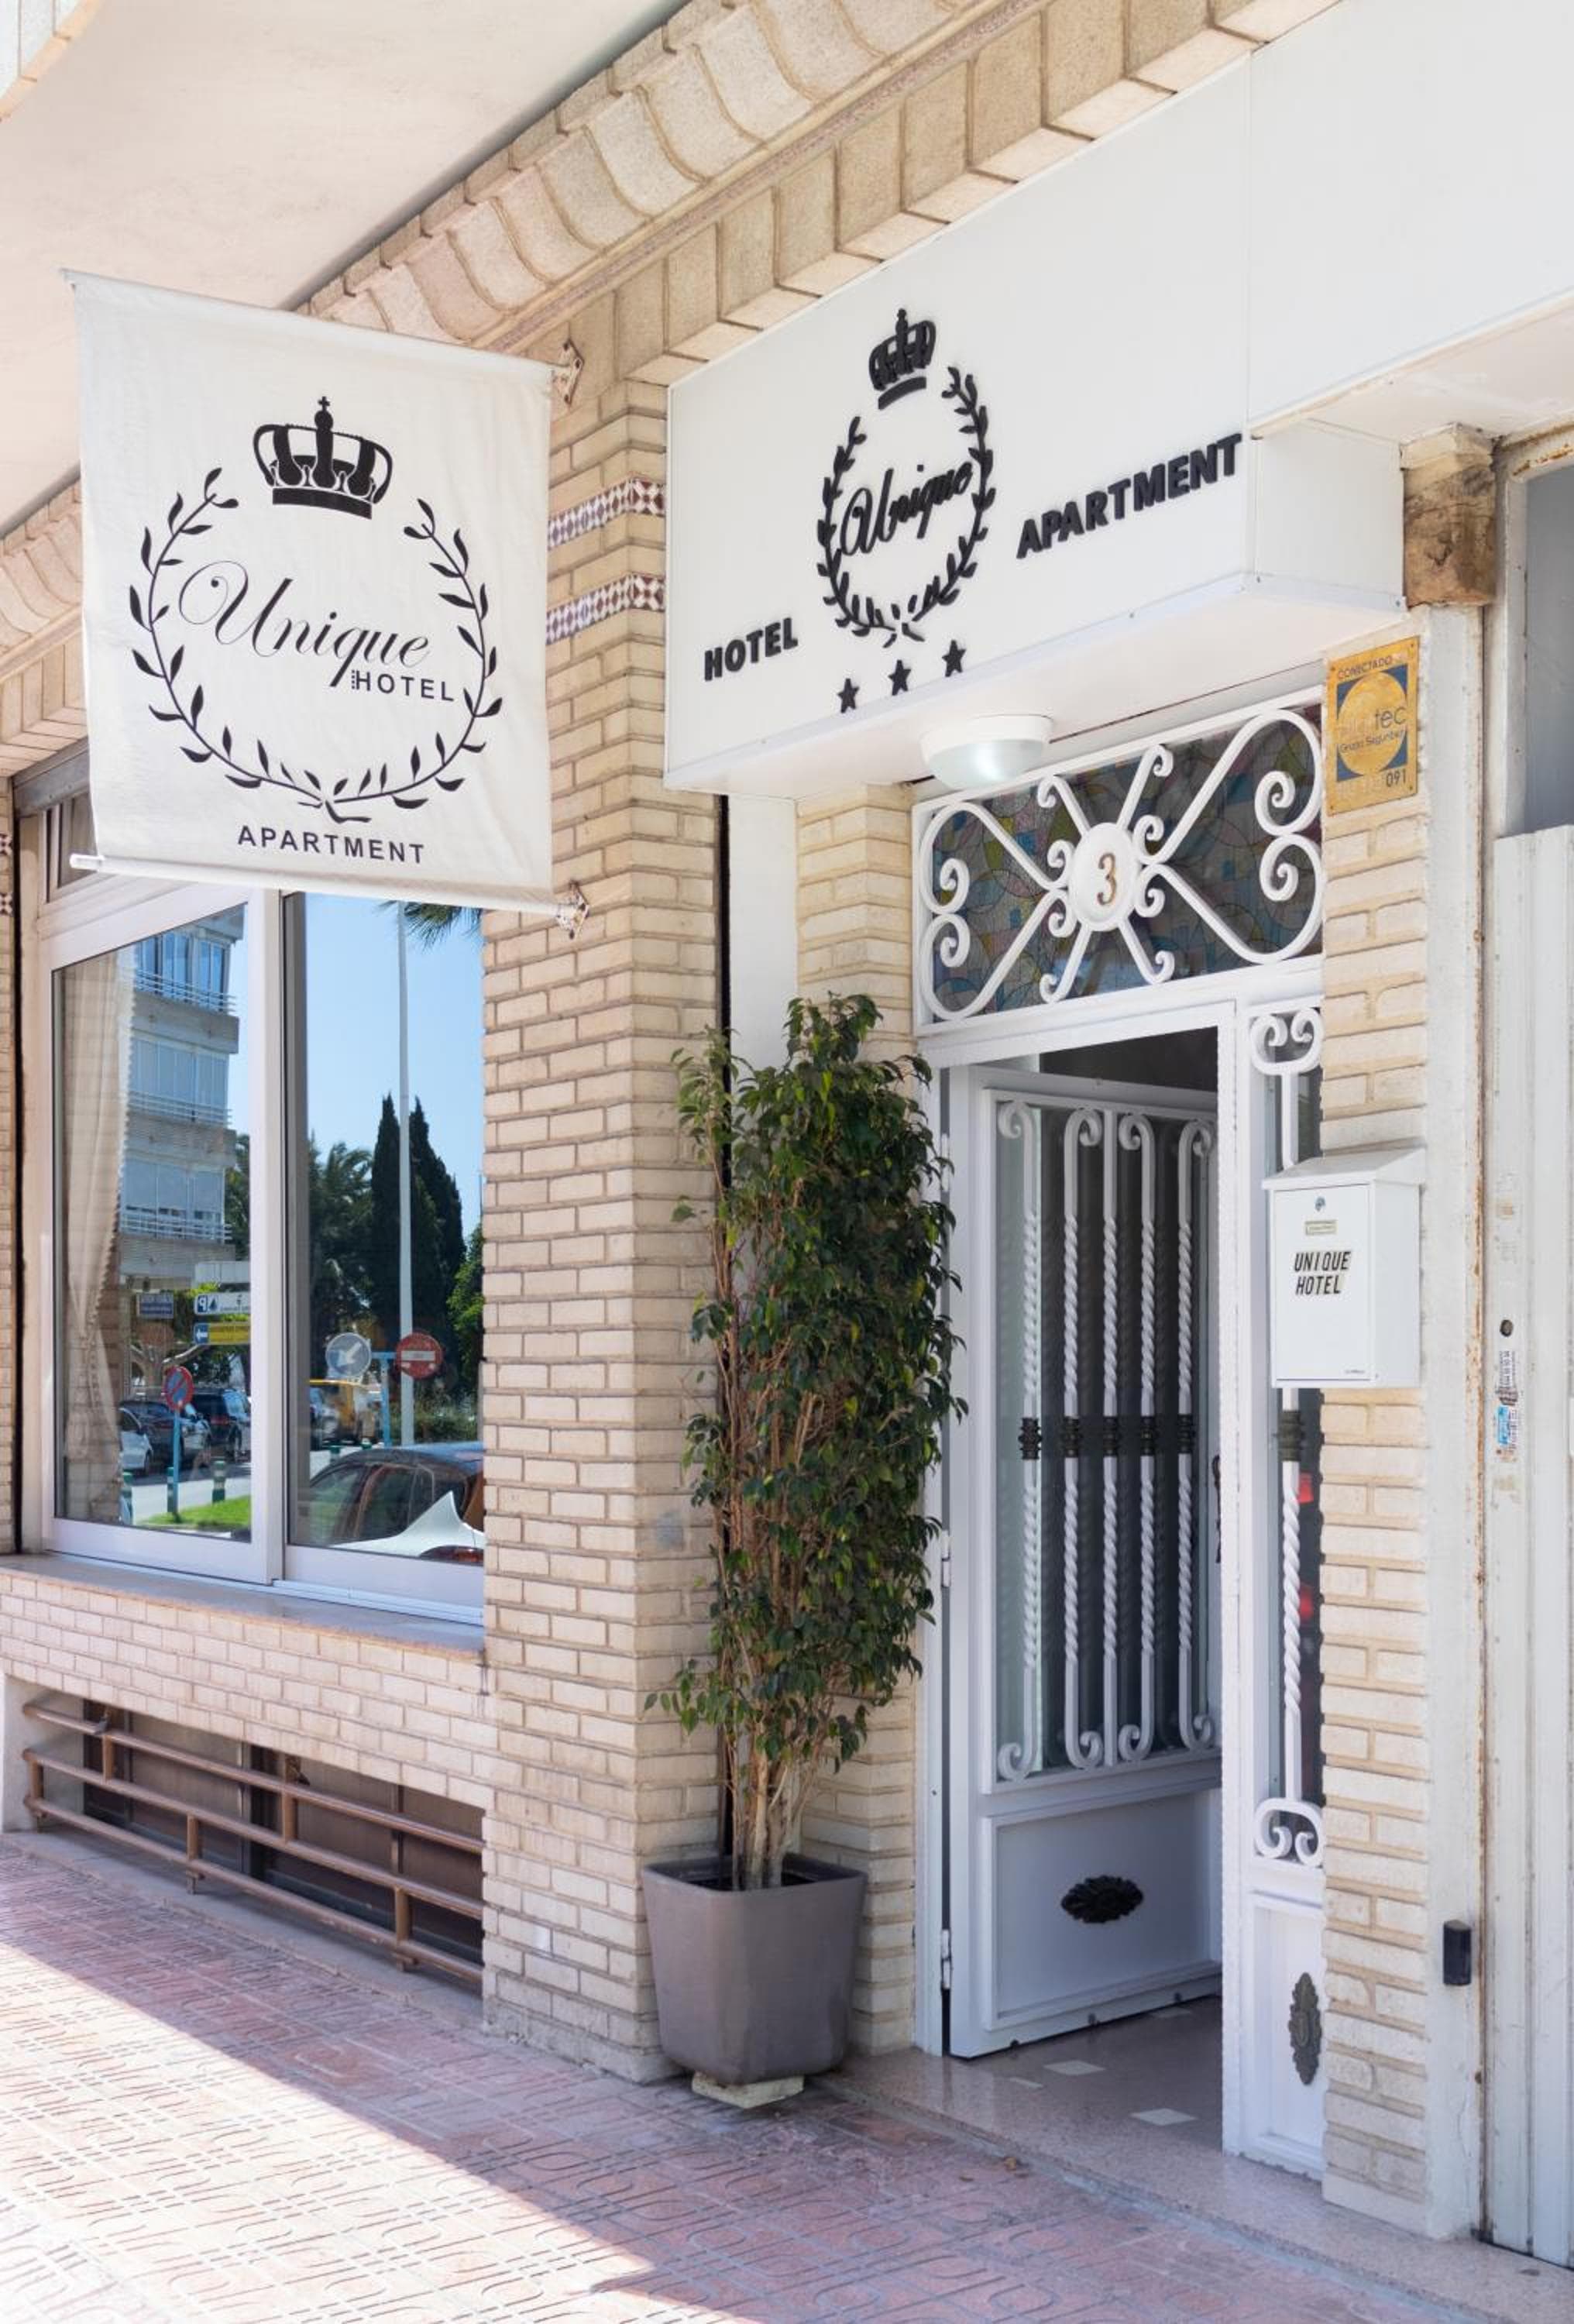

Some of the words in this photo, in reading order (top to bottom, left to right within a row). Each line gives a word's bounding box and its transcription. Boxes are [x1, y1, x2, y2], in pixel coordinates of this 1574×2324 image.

[840, 462, 973, 556] Unique
[1016, 434, 1242, 559] APARTMENT
[178, 561, 430, 687] Unique
[704, 618, 799, 681] HOTEL
[356, 670, 454, 701] HOTEL
[238, 826, 424, 863] APARTMENT
[1097, 853, 1117, 906] 3
[1294, 1251, 1351, 1272] UNIQUE
[1295, 1275, 1341, 1295] HOTEL
